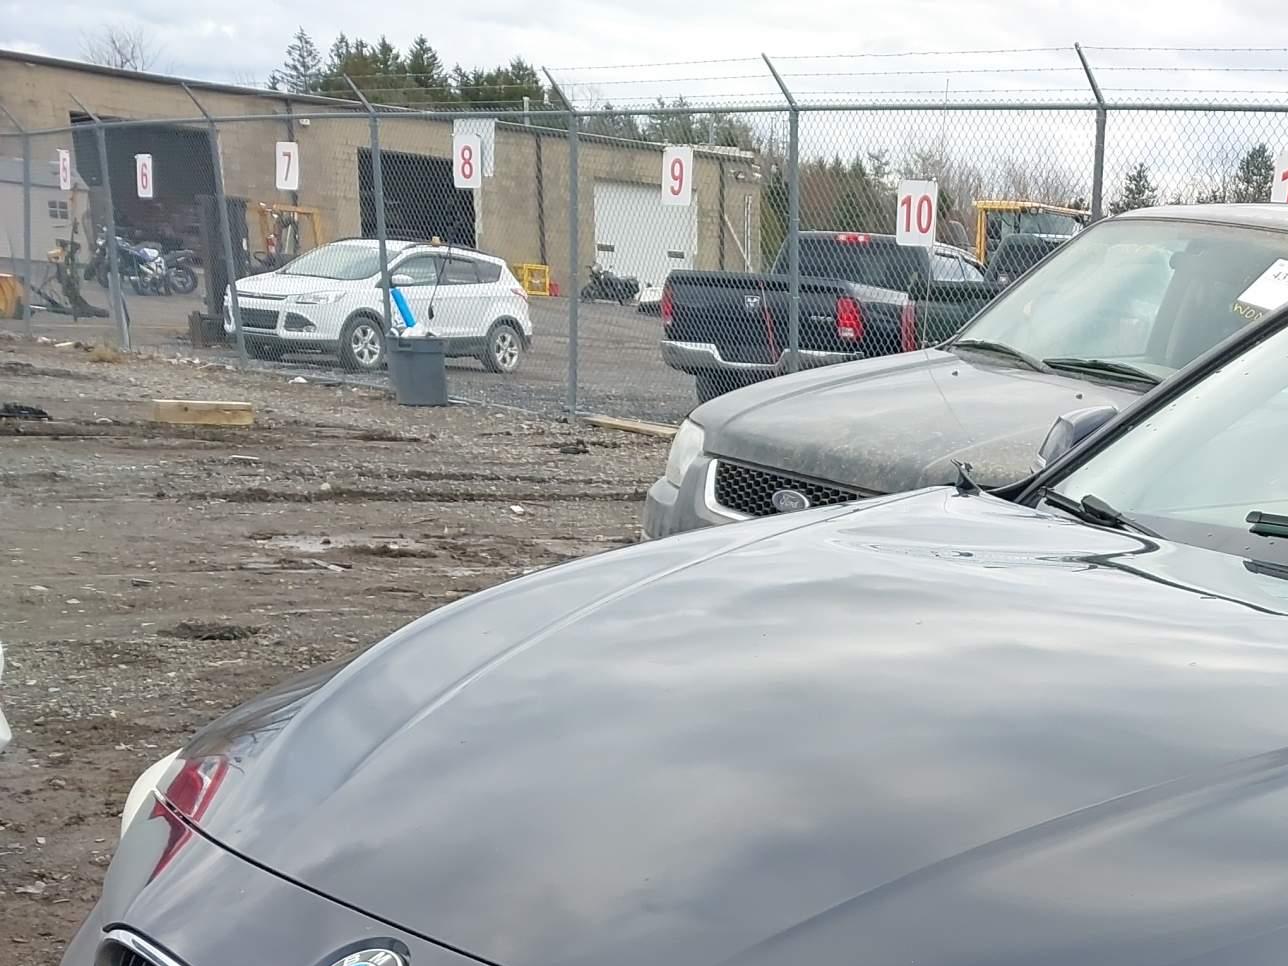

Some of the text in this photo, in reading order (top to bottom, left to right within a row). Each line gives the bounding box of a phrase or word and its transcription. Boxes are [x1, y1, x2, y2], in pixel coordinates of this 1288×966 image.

[140, 162, 149, 190] 6
[281, 151, 293, 182] 7
[460, 144, 474, 180] 8
[669, 157, 685, 196] 9
[899, 194, 933, 235] 10
